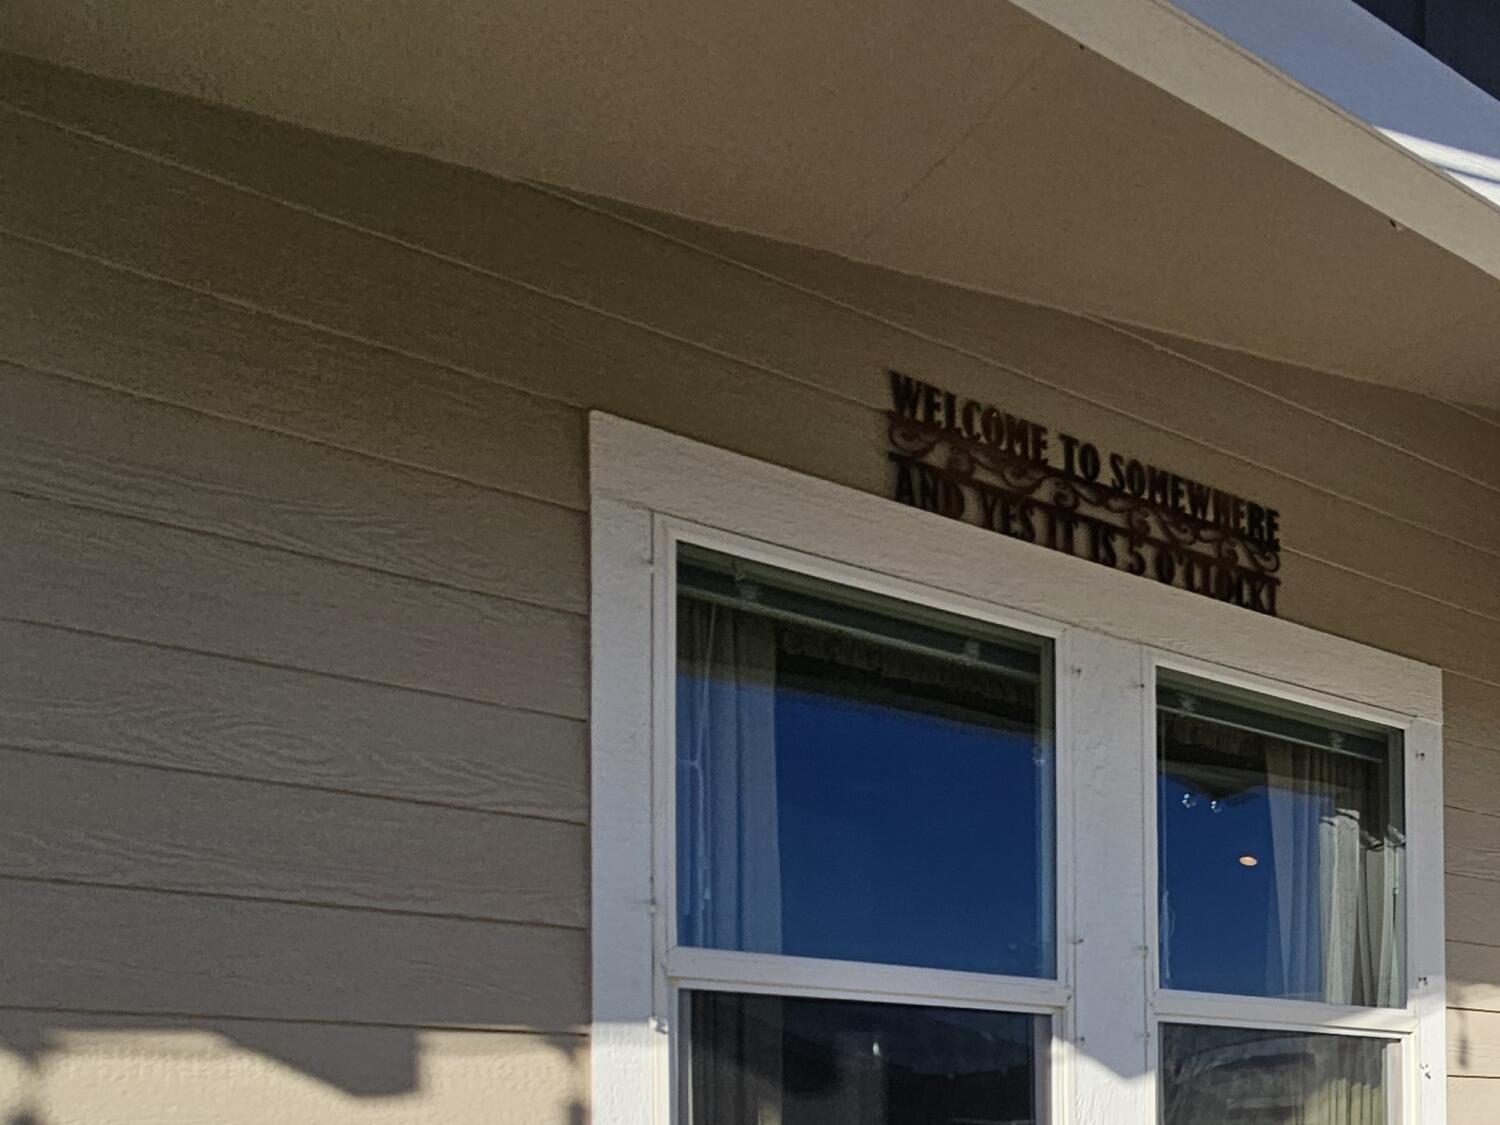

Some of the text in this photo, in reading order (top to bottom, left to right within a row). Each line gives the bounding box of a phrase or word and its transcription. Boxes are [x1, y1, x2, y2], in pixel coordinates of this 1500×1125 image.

[889, 369, 1281, 551] WELCOME TO SOMEWHERE
[895, 460, 965, 521] AND
[980, 491, 1037, 544] YES
[1046, 511, 1080, 558] IT
[1090, 522, 1116, 570] IS
